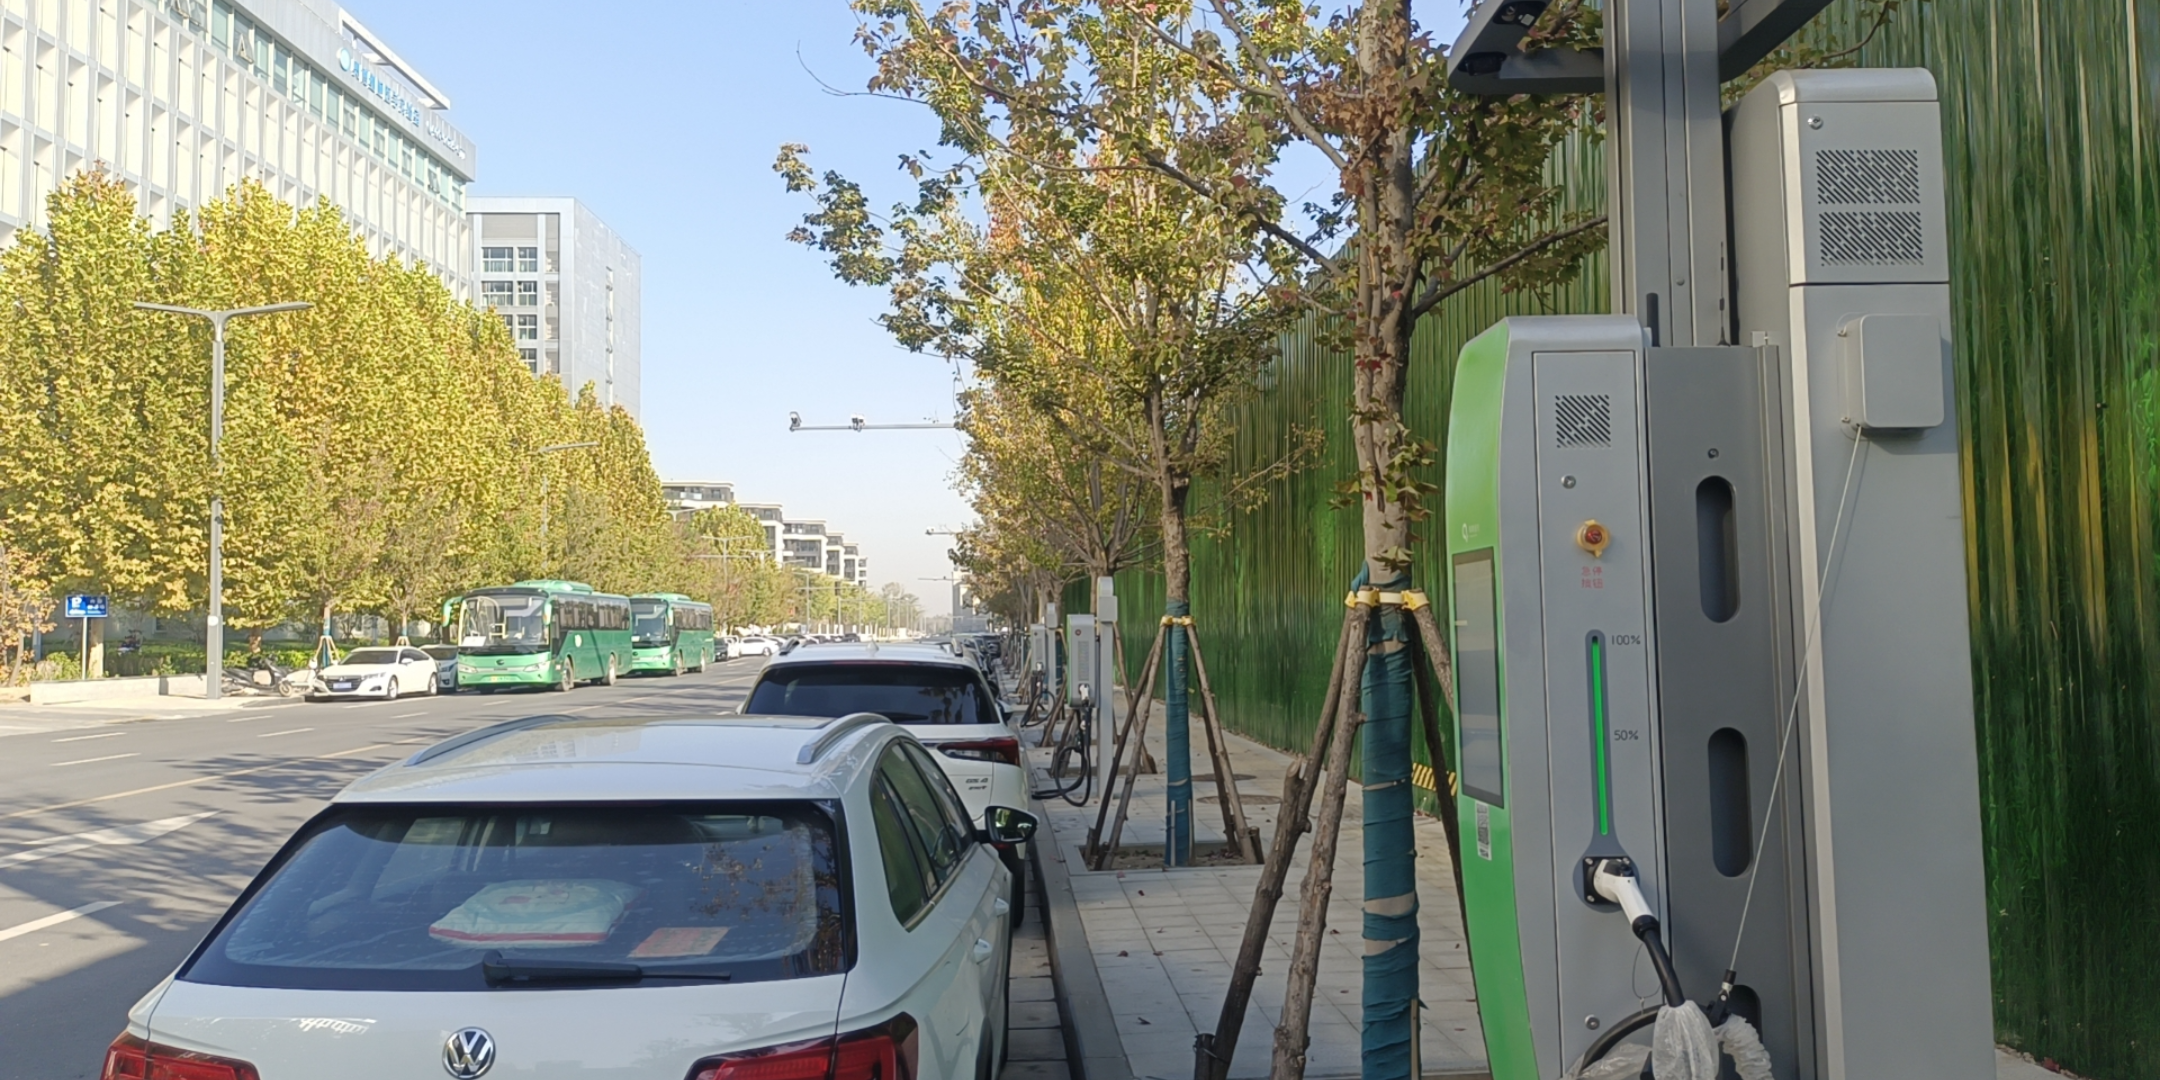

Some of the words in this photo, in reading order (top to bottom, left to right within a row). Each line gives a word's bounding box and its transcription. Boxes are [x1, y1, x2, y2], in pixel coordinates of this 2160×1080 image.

[1581, 565, 1603, 576] 急停
[1581, 578, 1603, 589] 按钮
[1611, 634, 1641, 646] 100%
[1613, 729, 1639, 741] 50%
